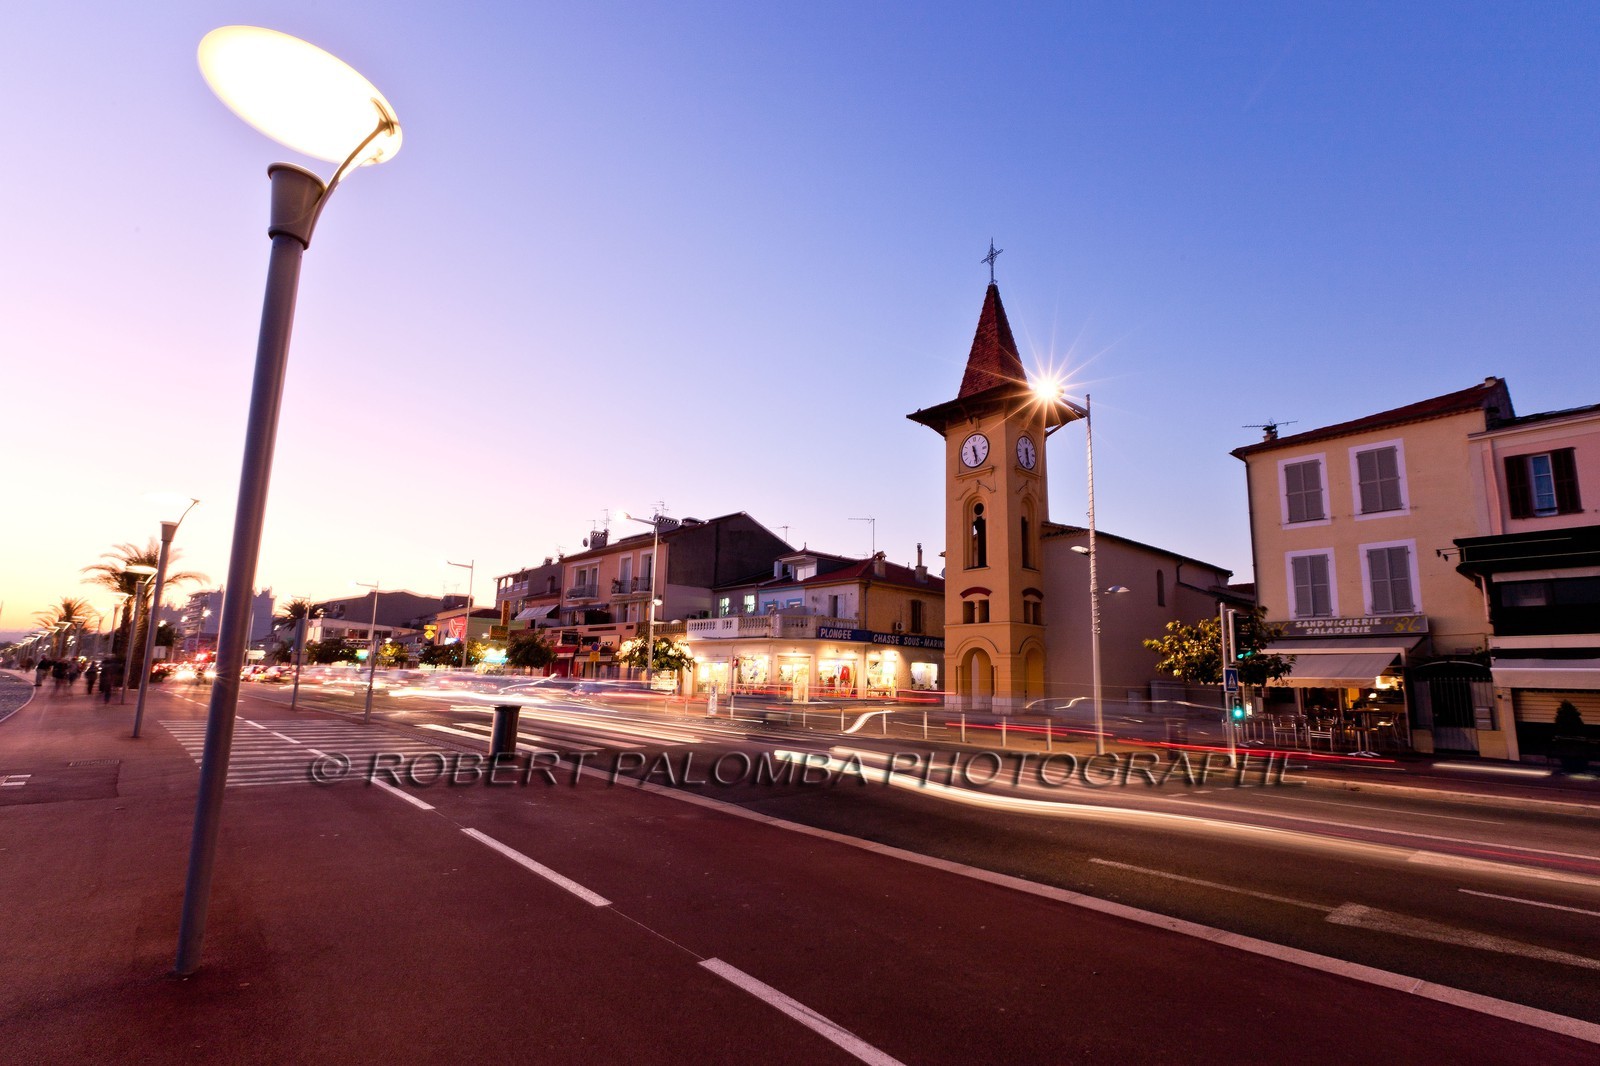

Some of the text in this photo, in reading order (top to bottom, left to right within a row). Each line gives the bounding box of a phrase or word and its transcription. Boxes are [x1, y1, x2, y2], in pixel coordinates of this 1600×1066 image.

[1295, 618, 1382, 628] SANDWICHERIE
[1306, 626, 1371, 635] SALADERIE
[873, 633, 945, 648] CHASSE SOUS-MARIN
